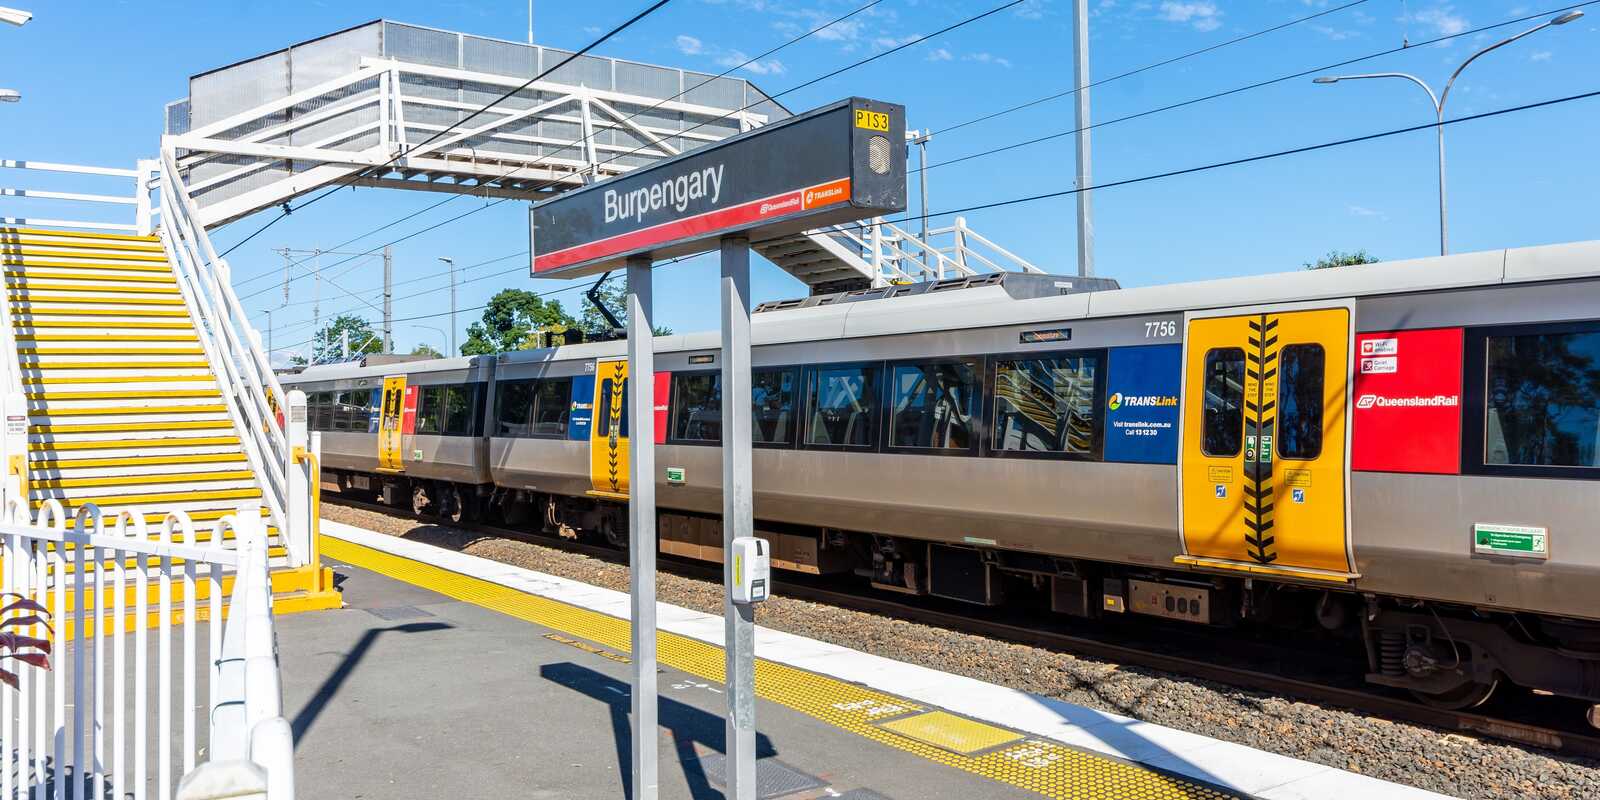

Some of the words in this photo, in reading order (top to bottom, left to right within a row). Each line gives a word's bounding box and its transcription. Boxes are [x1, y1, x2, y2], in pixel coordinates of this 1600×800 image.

[856, 111, 888, 129] PIS3
[604, 164, 724, 223] Burpengary
[1145, 321, 1176, 338] 7756
[1124, 396, 1178, 406] TRANSLink
[1376, 395, 1458, 406] QueenslandRail
